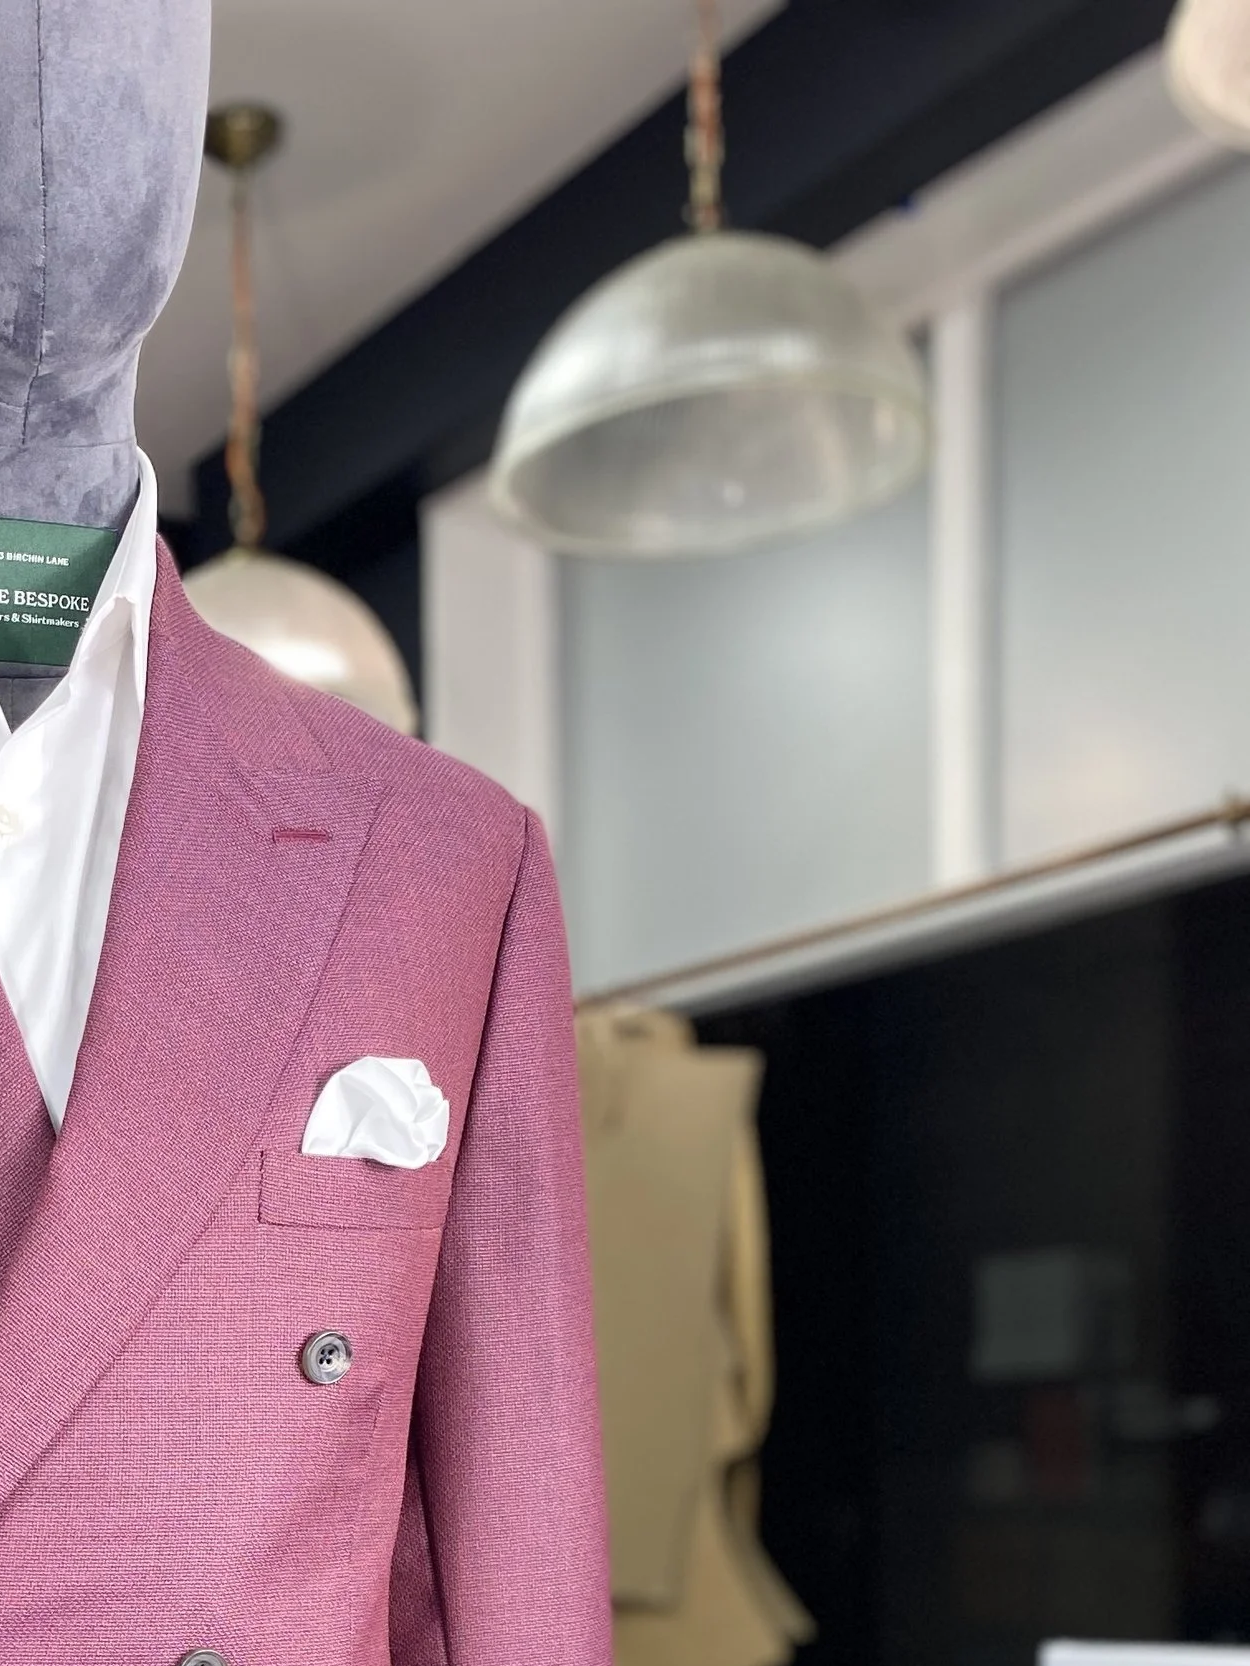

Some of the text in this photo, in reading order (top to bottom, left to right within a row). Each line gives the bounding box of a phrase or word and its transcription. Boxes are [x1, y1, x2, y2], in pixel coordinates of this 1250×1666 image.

[6, 552, 44, 564] BIRCHIN
[46, 556, 70, 566] LANE
[14, 590, 90, 611] BESPOKE
[11, 613, 20, 623] &
[21, 614, 79, 628] Shirtmakers
